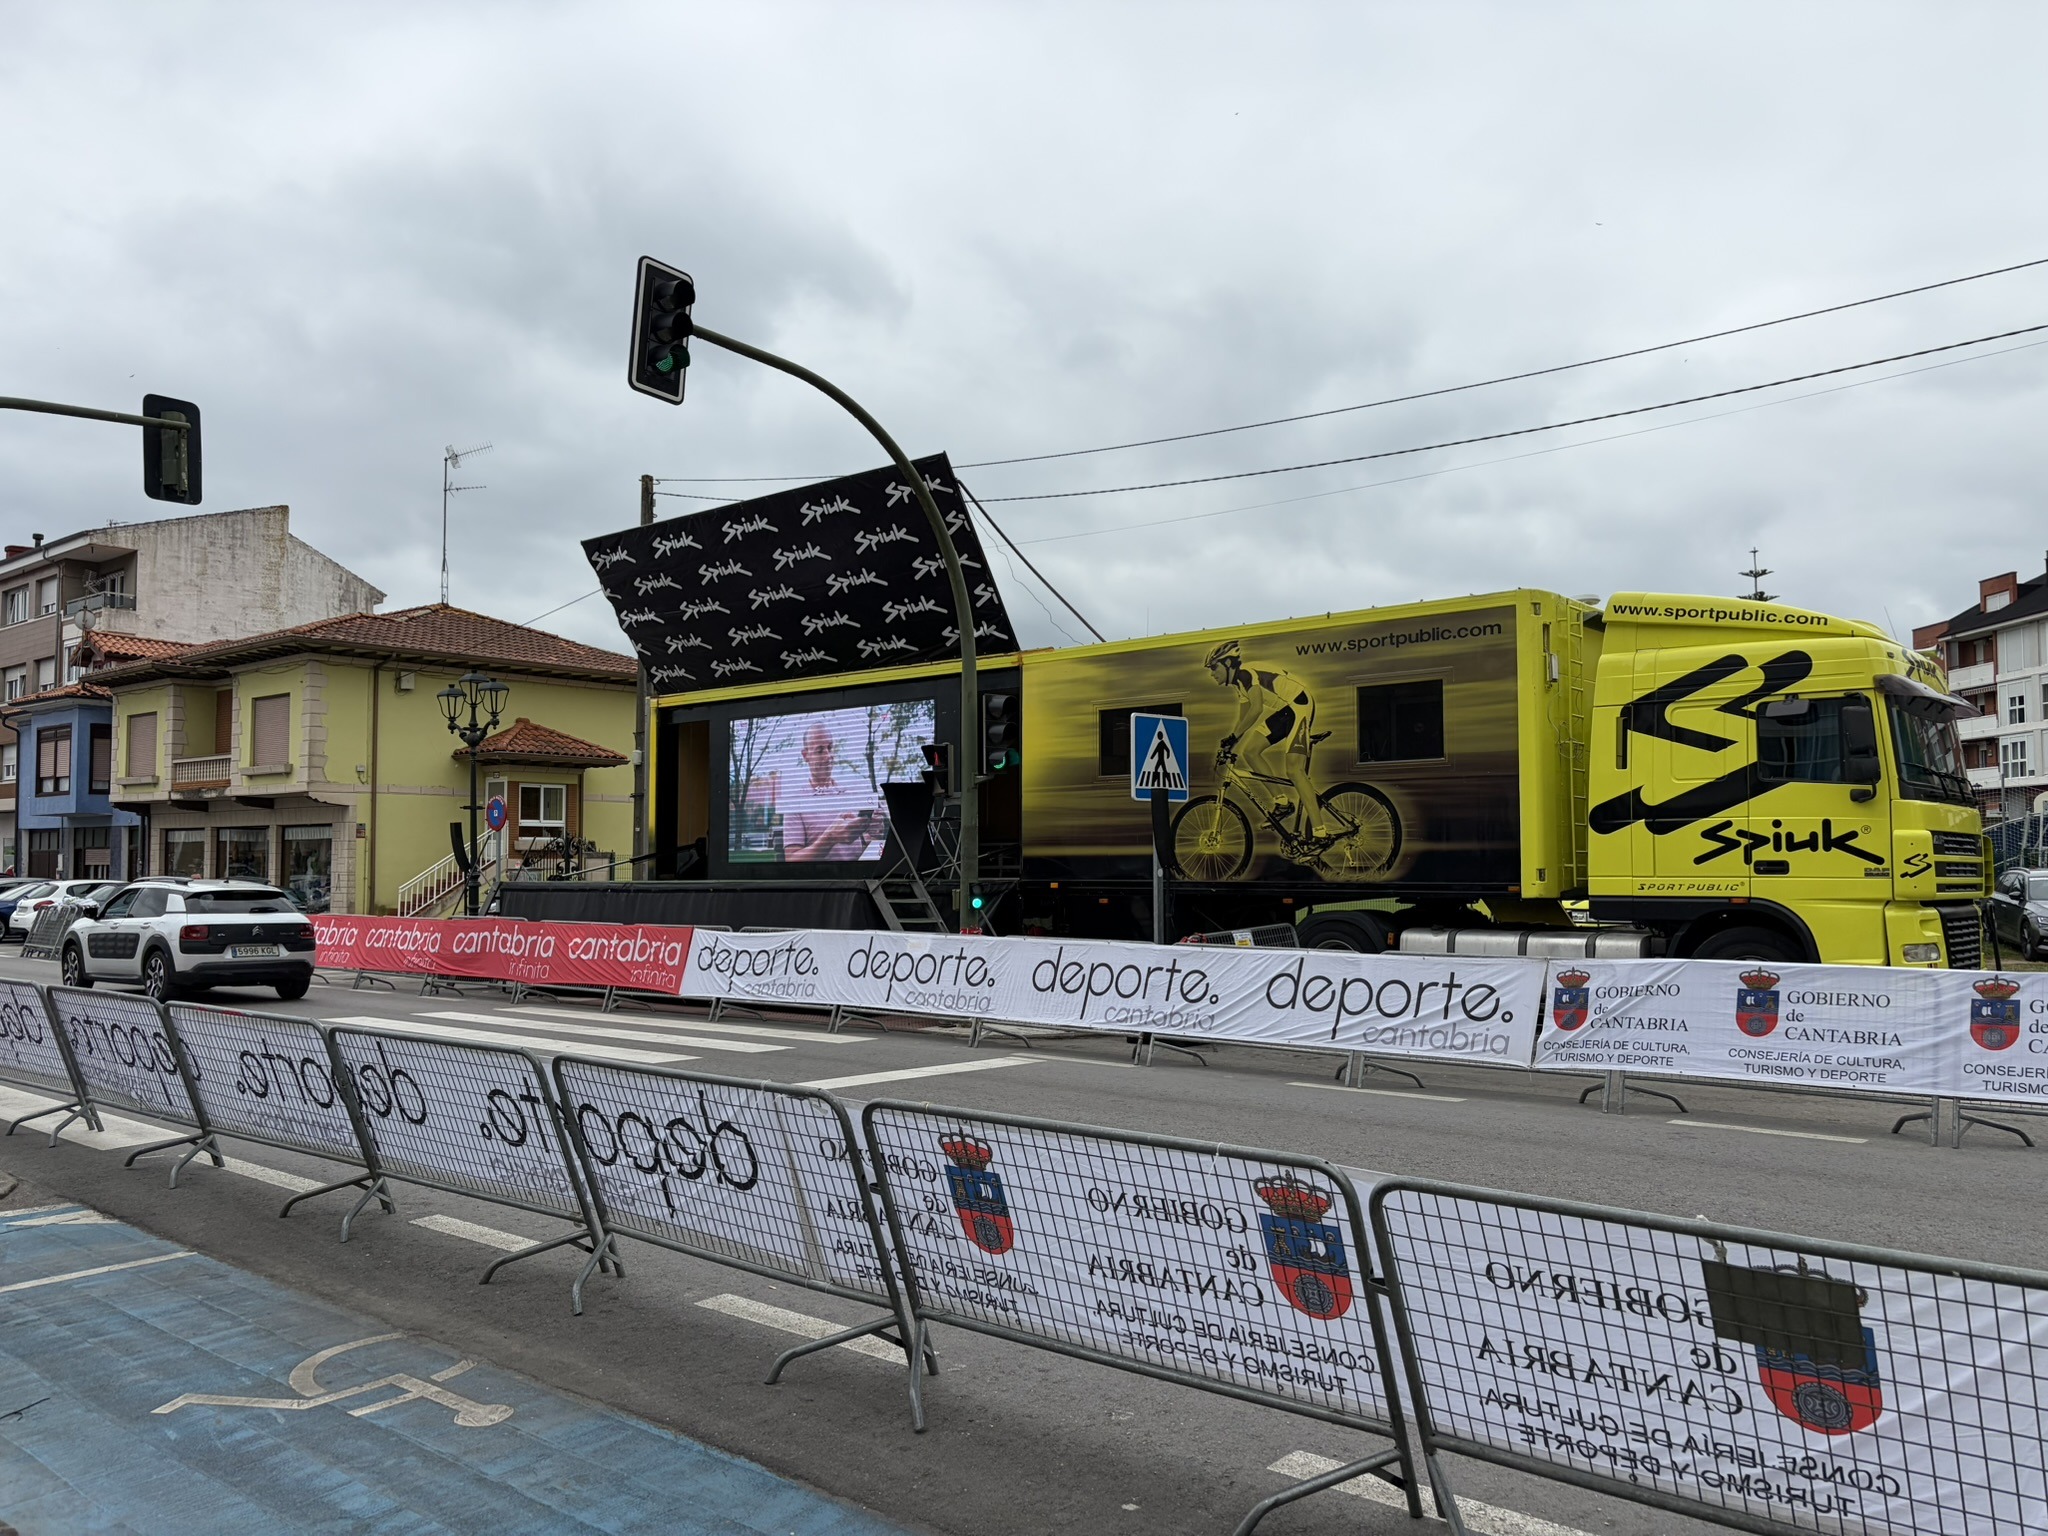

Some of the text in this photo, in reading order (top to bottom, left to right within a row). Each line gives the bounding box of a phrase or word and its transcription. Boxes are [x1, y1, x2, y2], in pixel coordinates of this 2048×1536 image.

[885, 474, 953, 507] Spik
[800, 495, 861, 526] Spiuk
[722, 514, 778, 544] Spiuk
[854, 524, 919, 555] Spiuk
[652, 532, 702, 559] Spiuk
[773, 542, 831, 571] Spiuk
[592, 546, 636, 571] Spiuk
[912, 553, 981, 580] Spik
[634, 573, 682, 596] Spiuk
[699, 559, 752, 586] Spiuk
[826, 568, 888, 596] Spiuk
[680, 597, 730, 621] Spiuk
[749, 583, 805, 610] Spiuk
[882, 595, 948, 623] Spiuk
[621, 607, 664, 629] Spiuk
[801, 610, 861, 636] Spiuk
[1613, 604, 1829, 626] www.sportpublic.com
[665, 633, 712, 654] Spiuk
[728, 623, 782, 647] Spiuk
[857, 635, 919, 658] Spiuk
[1296, 623, 1502, 656] www.sportpublic.com
[711, 657, 763, 677] Spiuk
[780, 647, 838, 669] Spiuk
[650, 665, 696, 683] Spiuk
[314, 919, 358, 946] tabria
[365, 922, 442, 953] cantabria
[452, 925, 556, 958] cantabria
[568, 928, 683, 967] cantabria
[508, 958, 550, 979] infinita
[630, 963, 677, 989] infinita
[743, 978, 815, 997] cantabria
[904, 984, 992, 1012] cantabria
[1595, 984, 1681, 999] GOBIERNO
[1787, 990, 1891, 1009] GOBIERNO
[1104, 1003, 1216, 1031] cantabria
[1591, 1016, 1689, 1032] CANTABRIA
[1785, 1009, 1805, 1023] de
[1362, 1022, 1511, 1056] cantabria
[1613, 1040, 1629, 1050] DE
[1632, 1040, 1691, 1055] CULTURA,
[1785, 1026, 1903, 1047] CANTABRIA
[1554, 1052, 1674, 1067] TURISMO Y DEPORTE
[1728, 1048, 1906, 1071] CONSEJERÍA DE CULTURA,
[1744, 1063, 1887, 1083] TURISMO Y DEPORTE
